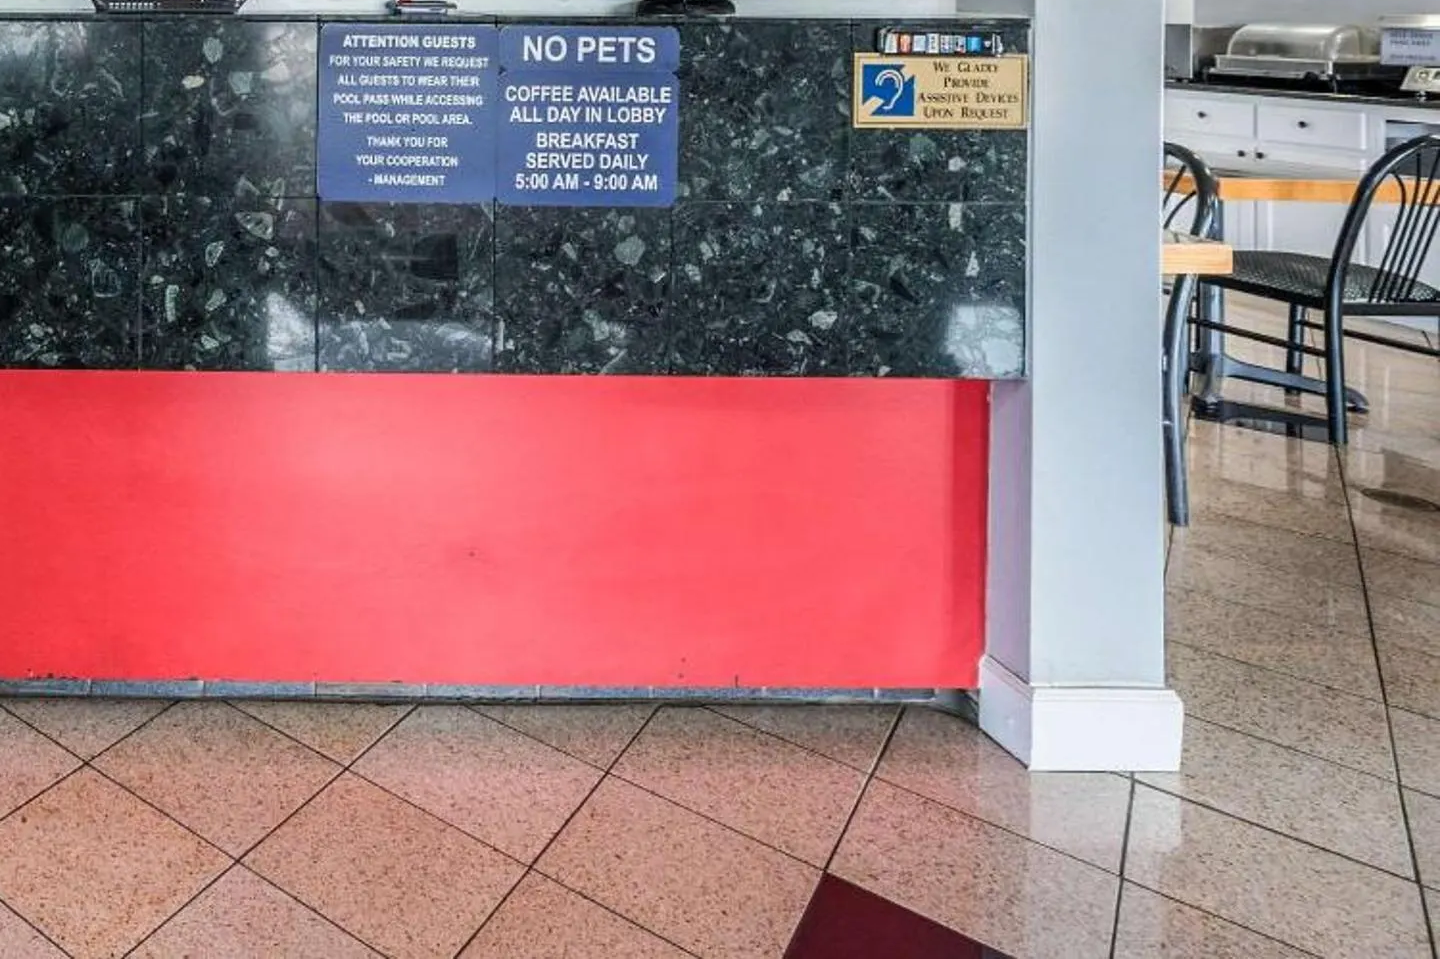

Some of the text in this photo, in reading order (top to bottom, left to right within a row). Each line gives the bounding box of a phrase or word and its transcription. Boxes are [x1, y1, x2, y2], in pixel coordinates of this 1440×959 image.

[343, 35, 477, 49] ATTENTION GUESTS
[523, 35, 656, 63] NO PETS
[329, 55, 489, 69] FOR YOUR SAFETY WE REQUEST
[338, 75, 480, 87] ALL GUESTS TO WEAR THEIR
[333, 93, 483, 106] POOL PASS WHILE ACCESSING
[505, 85, 672, 104] COFFEE AVAILABLE
[344, 112, 473, 125] THE POOL OR POOL AREA.
[509, 106, 667, 124] ALL DAY IN LOBBY
[367, 136, 448, 148] THANK YOU FOR
[536, 132, 640, 150] BREAKFAST
[355, 154, 459, 167] YOUR COOPERATION
[525, 152, 649, 170] SERVED DAILY
[374, 174, 446, 186] MANAGEMENT
[515, 173, 549, 190] 5:00
[552, 173, 579, 190] AM
[593, 174, 628, 190] 9:00
[631, 174, 658, 191] AM
